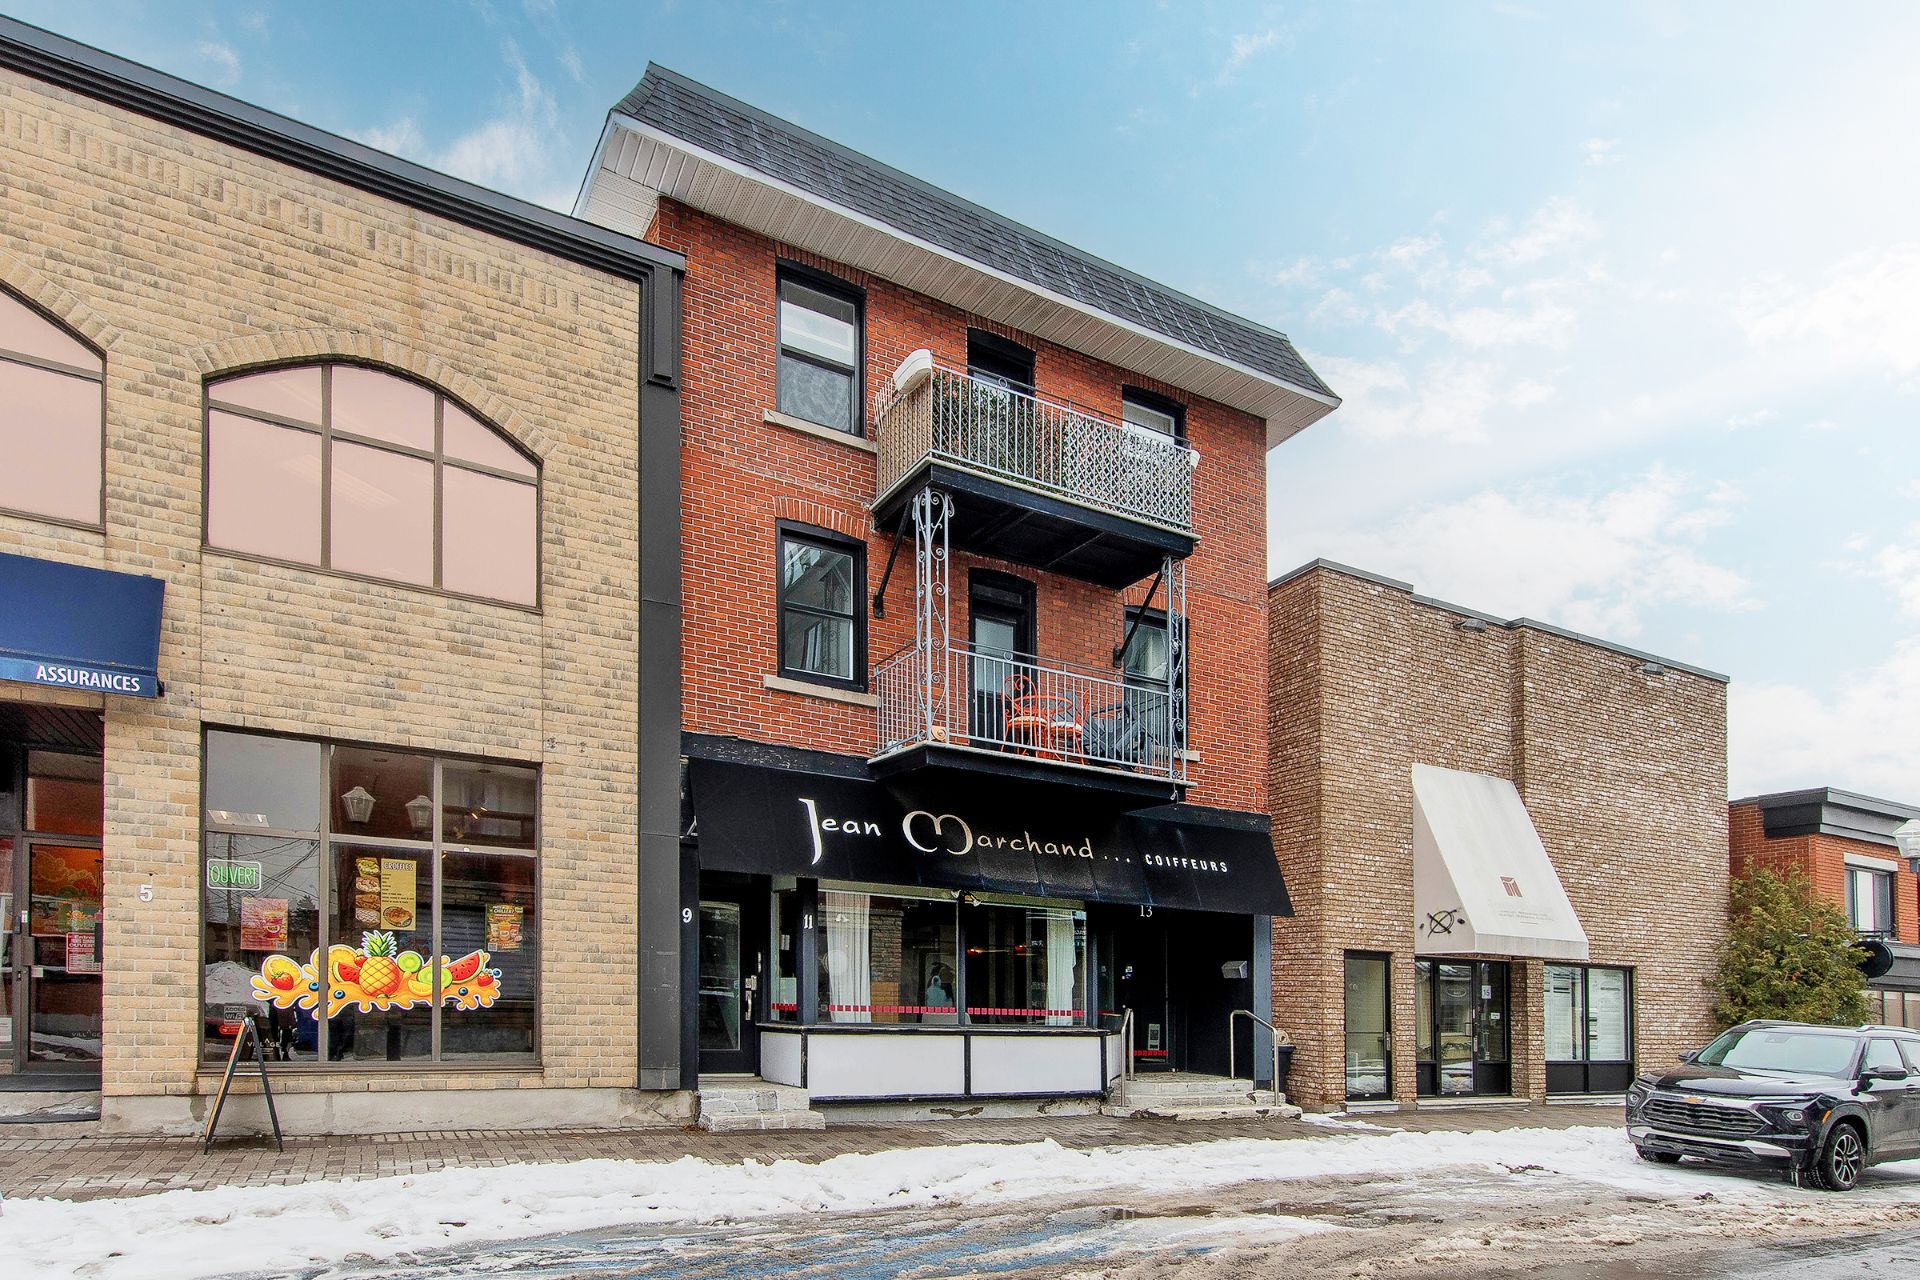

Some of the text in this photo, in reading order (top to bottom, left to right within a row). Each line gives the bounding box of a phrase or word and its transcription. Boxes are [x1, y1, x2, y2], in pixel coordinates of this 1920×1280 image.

[36, 664, 141, 693] ASSURANCES
[798, 798, 882, 865] Jean
[901, 810, 1094, 859] Marchand
[1145, 853, 1229, 873] COIFFEURS
[210, 864, 259, 885] OUVERT
[139, 884, 153, 903] 5
[682, 907, 693, 924] 9
[1139, 905, 1153, 918] 13
[803, 914, 814, 930] 11
